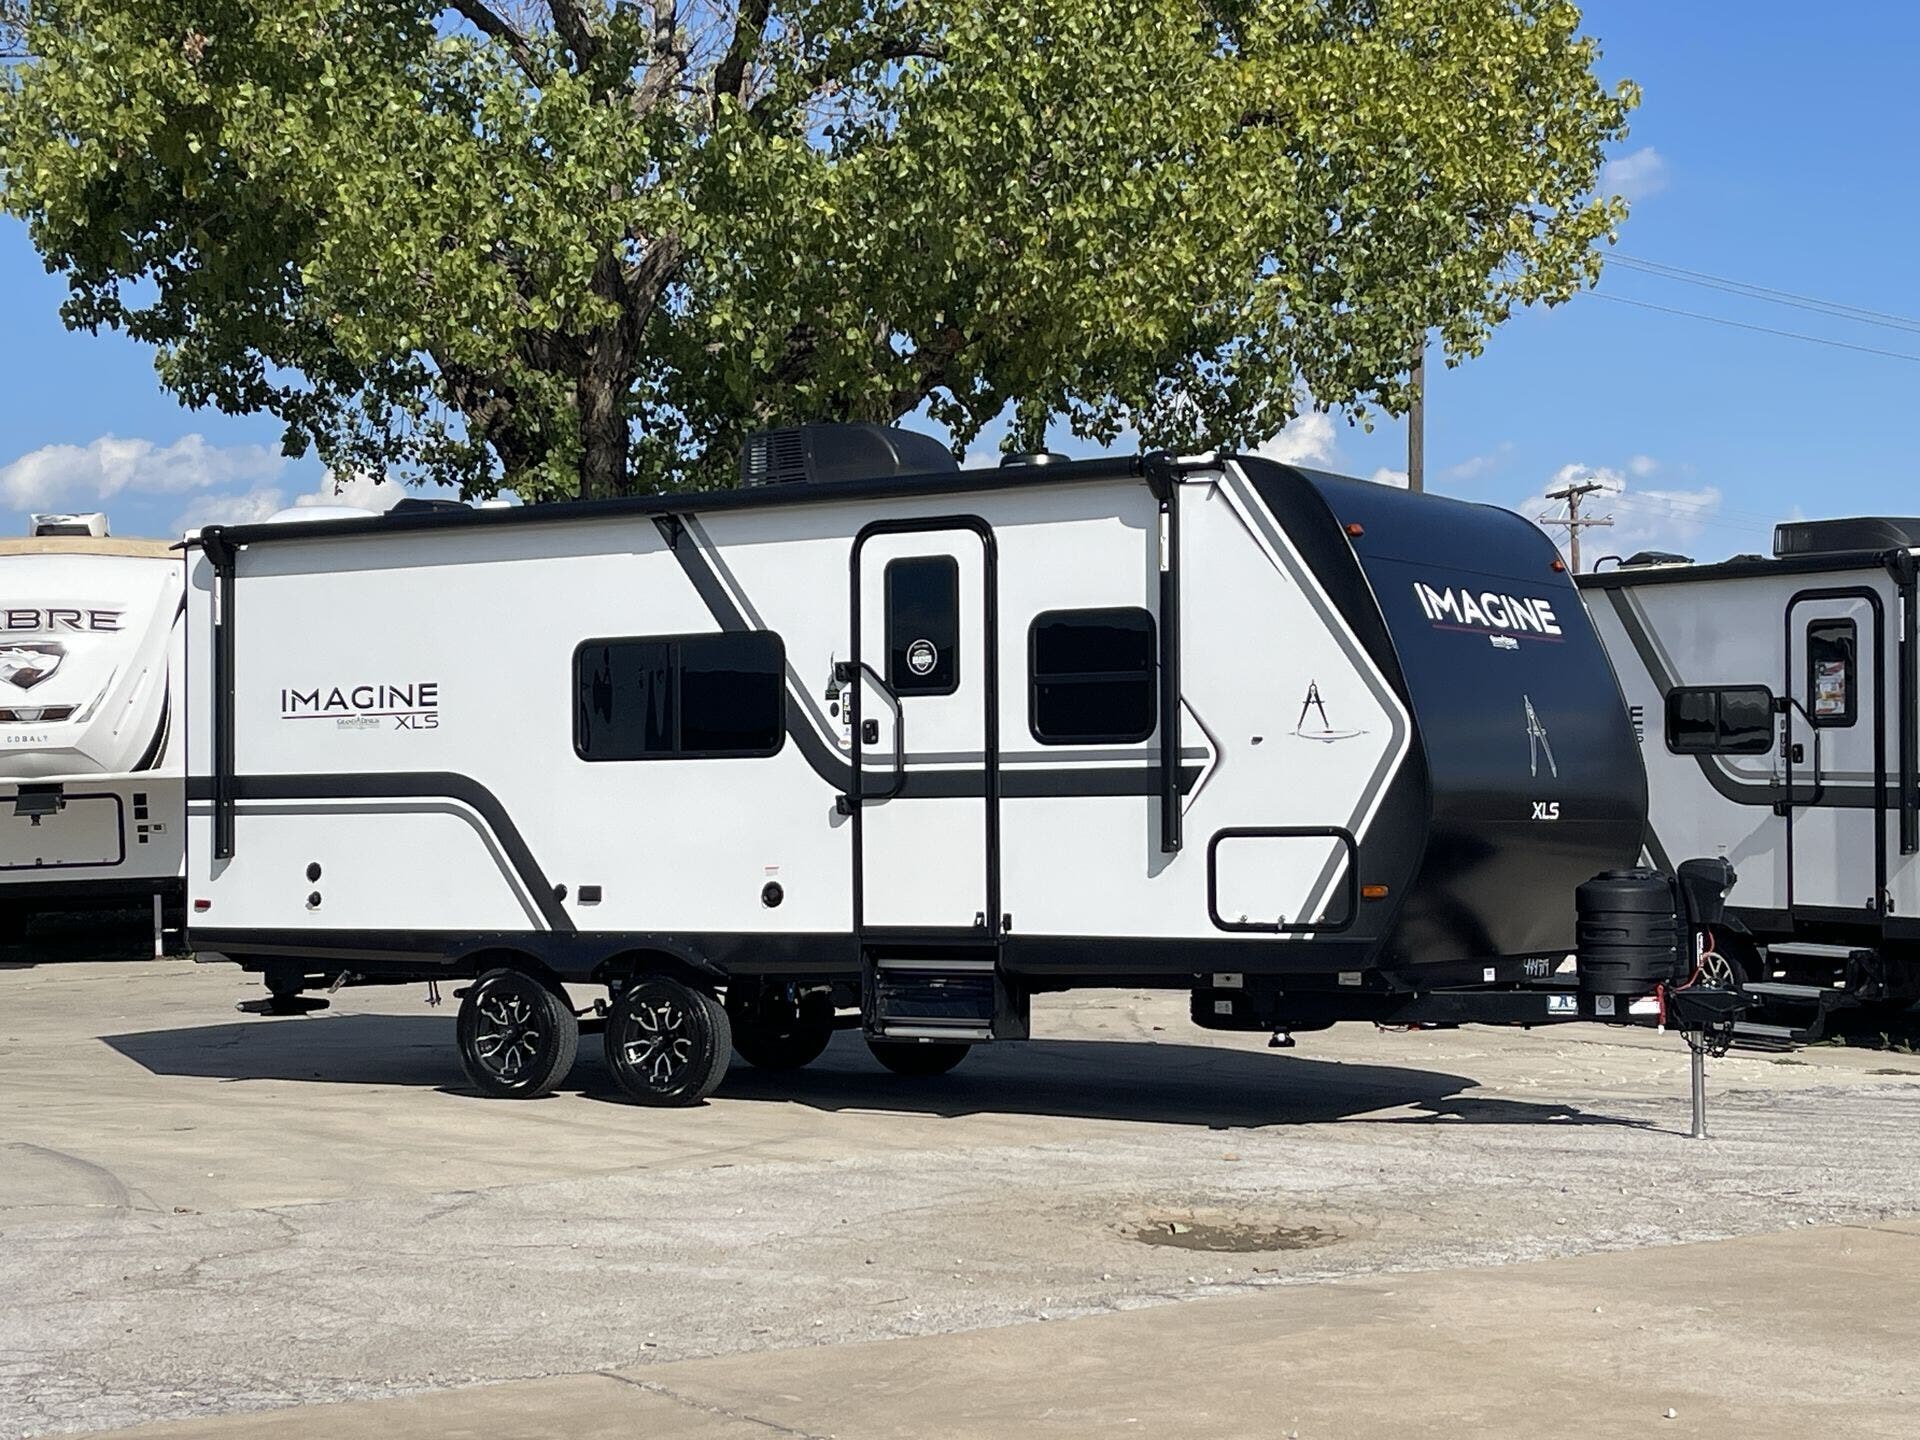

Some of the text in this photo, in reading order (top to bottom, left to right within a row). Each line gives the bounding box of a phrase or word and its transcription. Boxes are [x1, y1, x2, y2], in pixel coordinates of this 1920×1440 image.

[0, 607, 127, 632] BRE
[1413, 582, 1562, 635] IMAGINE
[281, 682, 438, 712] IMAGINE
[394, 714, 439, 730] XLS
[6, 734, 48, 743] COBALT
[1531, 801, 1560, 820] XLS
